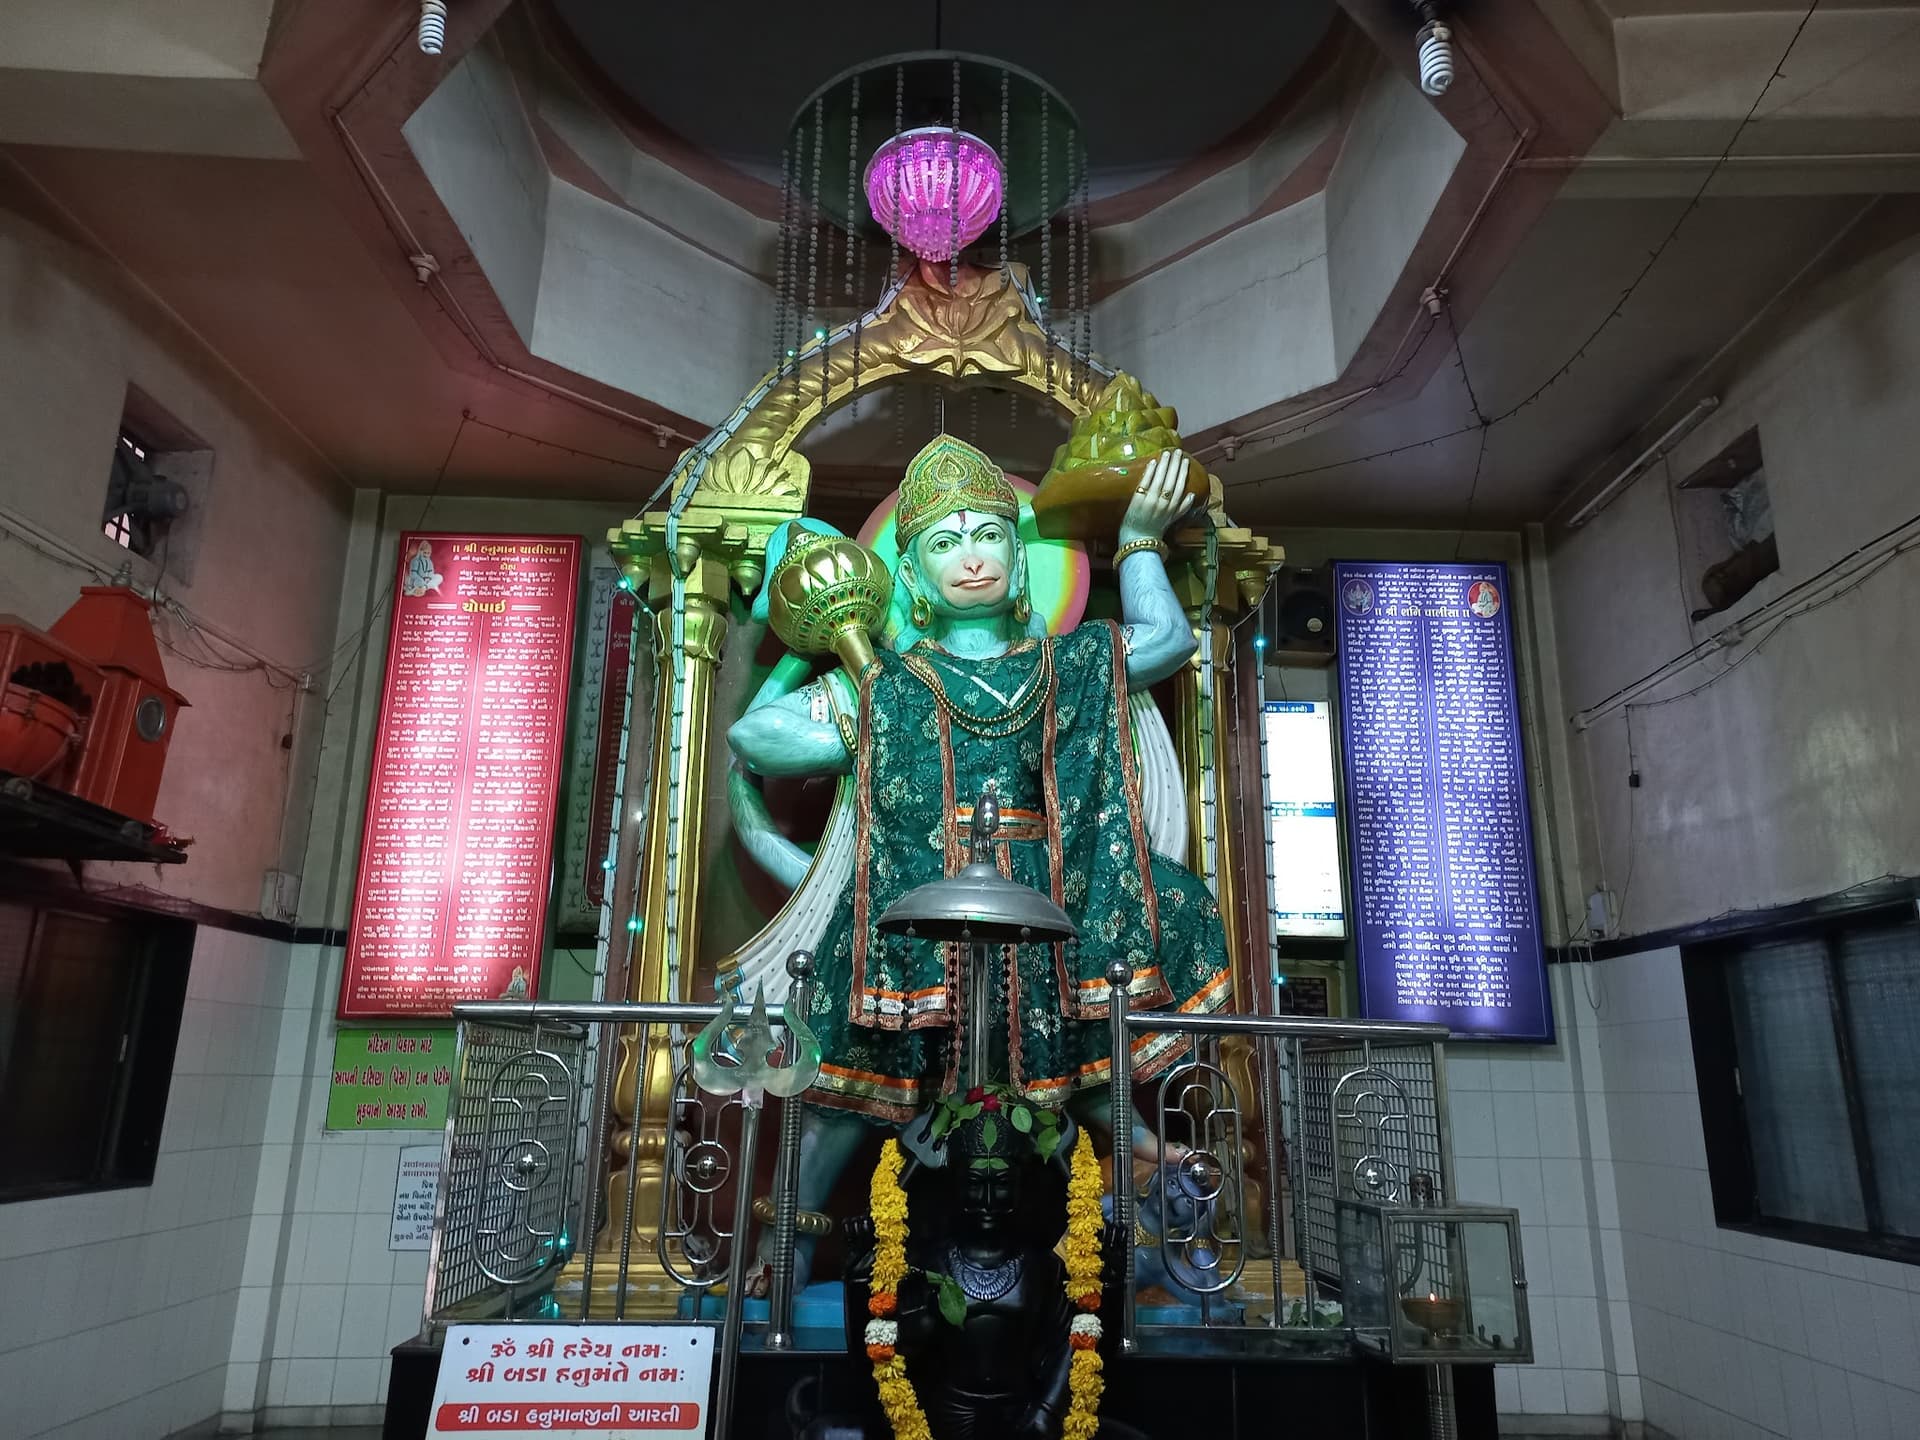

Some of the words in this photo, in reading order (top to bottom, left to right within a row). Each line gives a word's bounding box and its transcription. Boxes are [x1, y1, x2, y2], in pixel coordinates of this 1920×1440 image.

[463, 543, 477, 553] શ્રી
[480, 545, 516, 556] હનુમાન
[519, 544, 556, 554] ચાલીસા
[1385, 604, 1397, 617] શ્રી
[1400, 606, 1421, 617] શનિ
[335, 1064, 359, 1086] આપની
[526, 1337, 555, 1359] શ્રી
[563, 1337, 613, 1359] હરેય
[465, 1361, 495, 1383] શ્રી
[503, 1367, 546, 1382] બડા
[556, 1361, 630, 1387] હનુમંતે
[457, 1404, 480, 1424] શ્રી
[486, 1408, 518, 1423] બડા
[525, 1404, 621, 1428] હનુમાનજીની
[628, 1404, 681, 1423] આરતી
